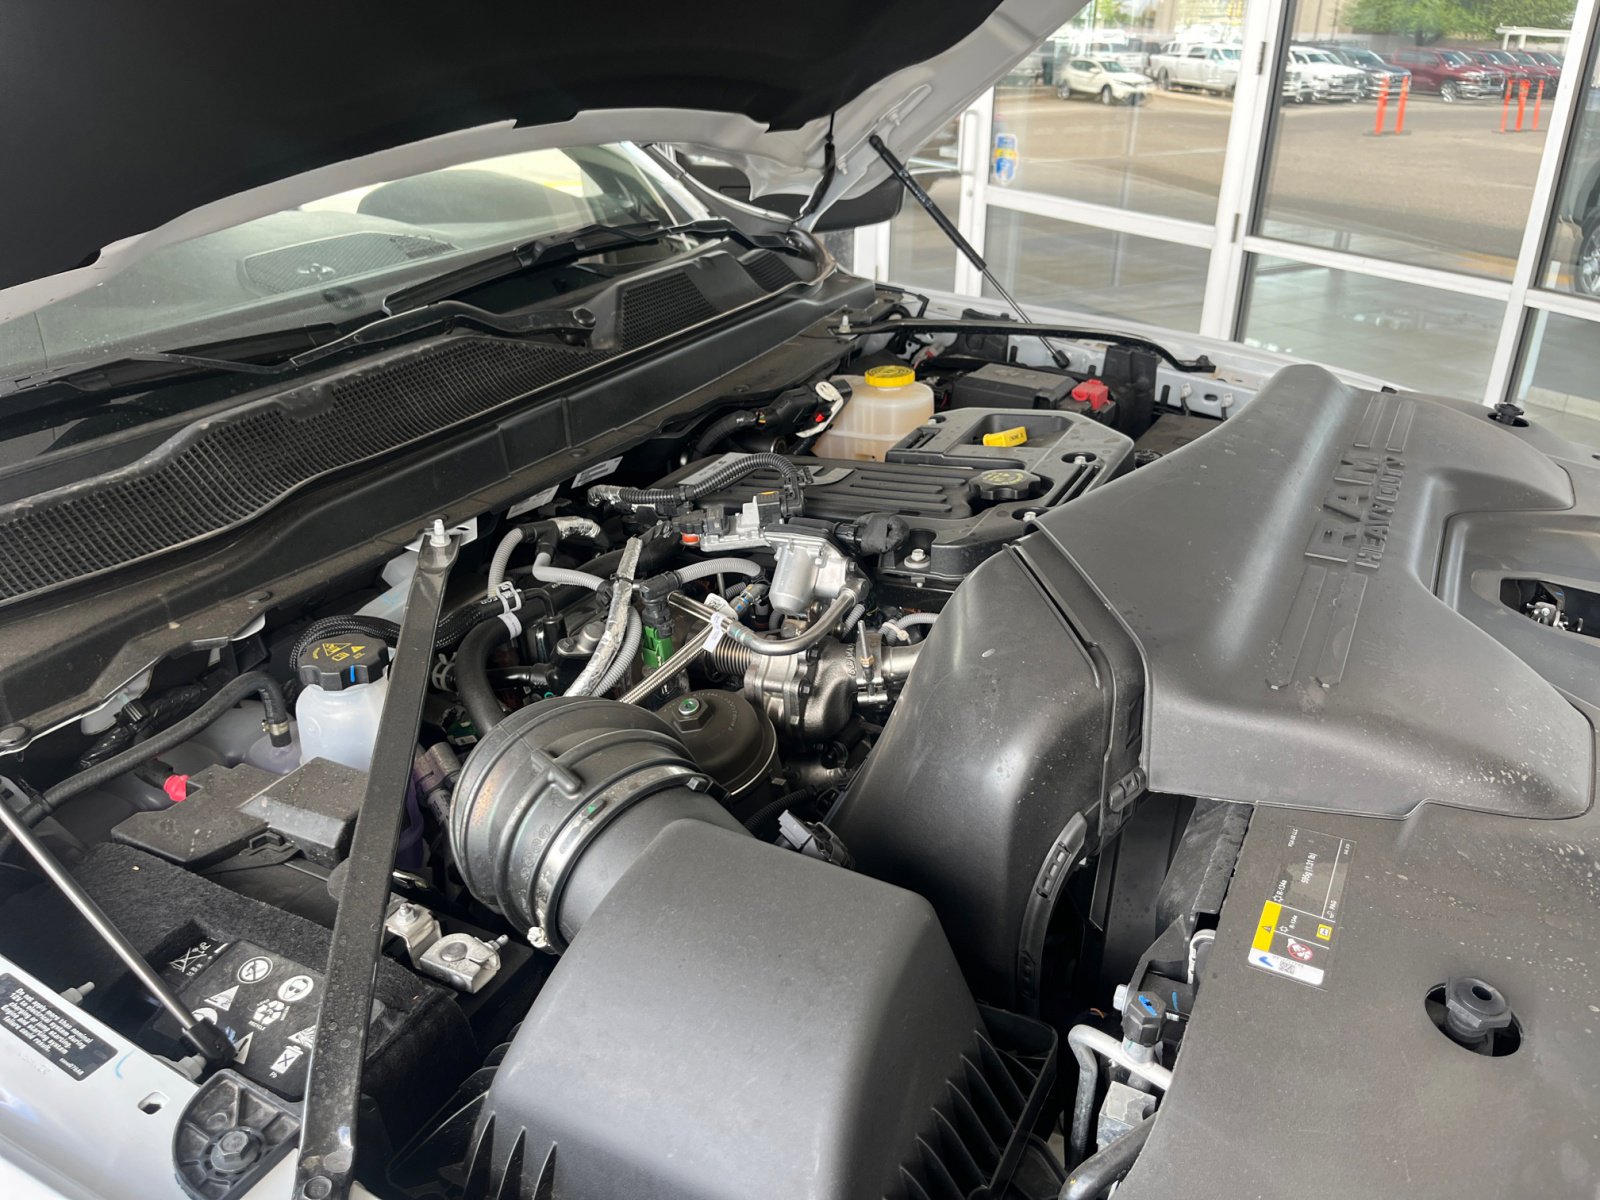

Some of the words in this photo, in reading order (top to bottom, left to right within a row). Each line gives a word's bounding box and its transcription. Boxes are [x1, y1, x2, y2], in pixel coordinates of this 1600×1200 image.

[1304, 453, 1380, 563] RAM
[1356, 502, 1394, 568] HEAVY
[1375, 456, 1406, 502] DUTY
[1277, 880, 1288, 895] R-134a
[1289, 915, 1298, 929] R-134a
[1, 1004, 20, 1019] Engine
[17, 1017, 30, 1026] and
[27, 1024, 50, 1042] starting
[47, 1039, 69, 1054] system
[3, 1016, 21, 1030] failure
[19, 1028, 37, 1040] could
[9, 1002, 32, 1019] charging
[35, 1021, 50, 1032] jump
[10, 992, 24, 1002] 12V
[26, 1005, 53, 1024] electrical
[49, 1022, 70, 1037] system
[68, 1035, 87, 1049] during
[15, 988, 25, 996] Do
[23, 994, 34, 1002] not
[32, 1001, 48, 1012] apply
[45, 1010, 60, 1020] more
[58, 1019, 72, 1029] than
[70, 1028, 94, 1044] nominal
